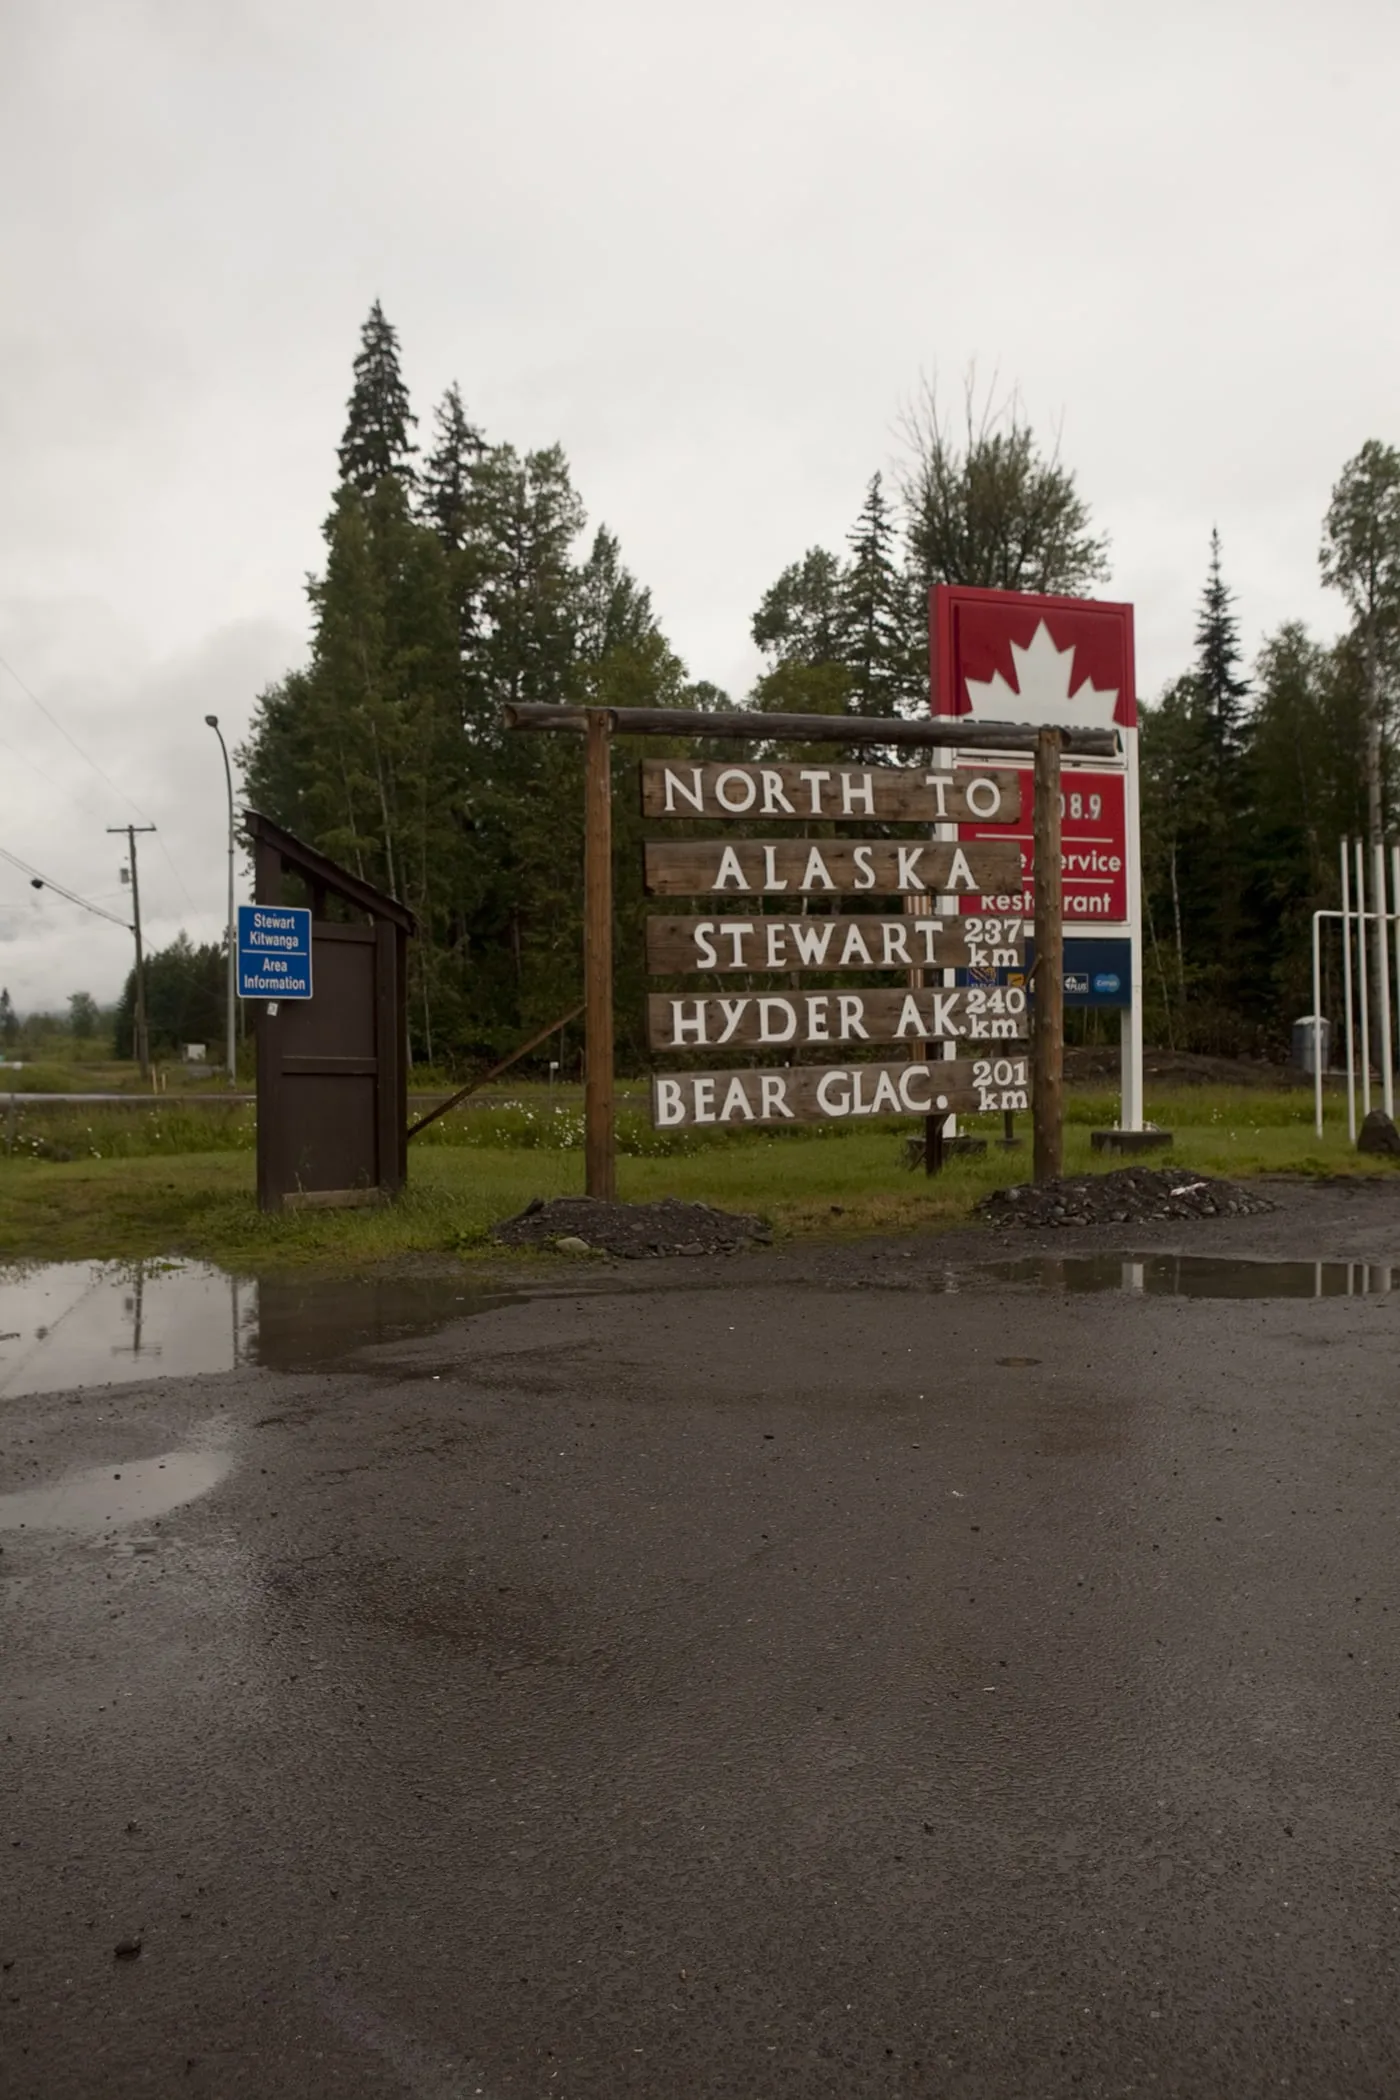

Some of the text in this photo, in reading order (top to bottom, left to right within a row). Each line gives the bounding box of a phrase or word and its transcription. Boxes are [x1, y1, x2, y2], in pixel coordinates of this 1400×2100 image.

[664, 768, 1000, 817] NORTH TO
[711, 846, 980, 889] ALASKA
[253, 913, 295, 929] Stewart
[964, 918, 1022, 944] 237
[249, 931, 299, 950] Kitwanga
[694, 922, 943, 969] STEWART
[262, 957, 288, 972] Area
[968, 943, 1020, 968] km
[243, 974, 306, 990] Information
[965, 987, 1026, 1015] 240
[670, 993, 967, 1045] HYDER AK.
[969, 1014, 1019, 1039] km
[972, 1060, 1028, 1088] 201
[656, 1065, 949, 1126] BEAR GLAC.
[977, 1086, 1029, 1111] km
